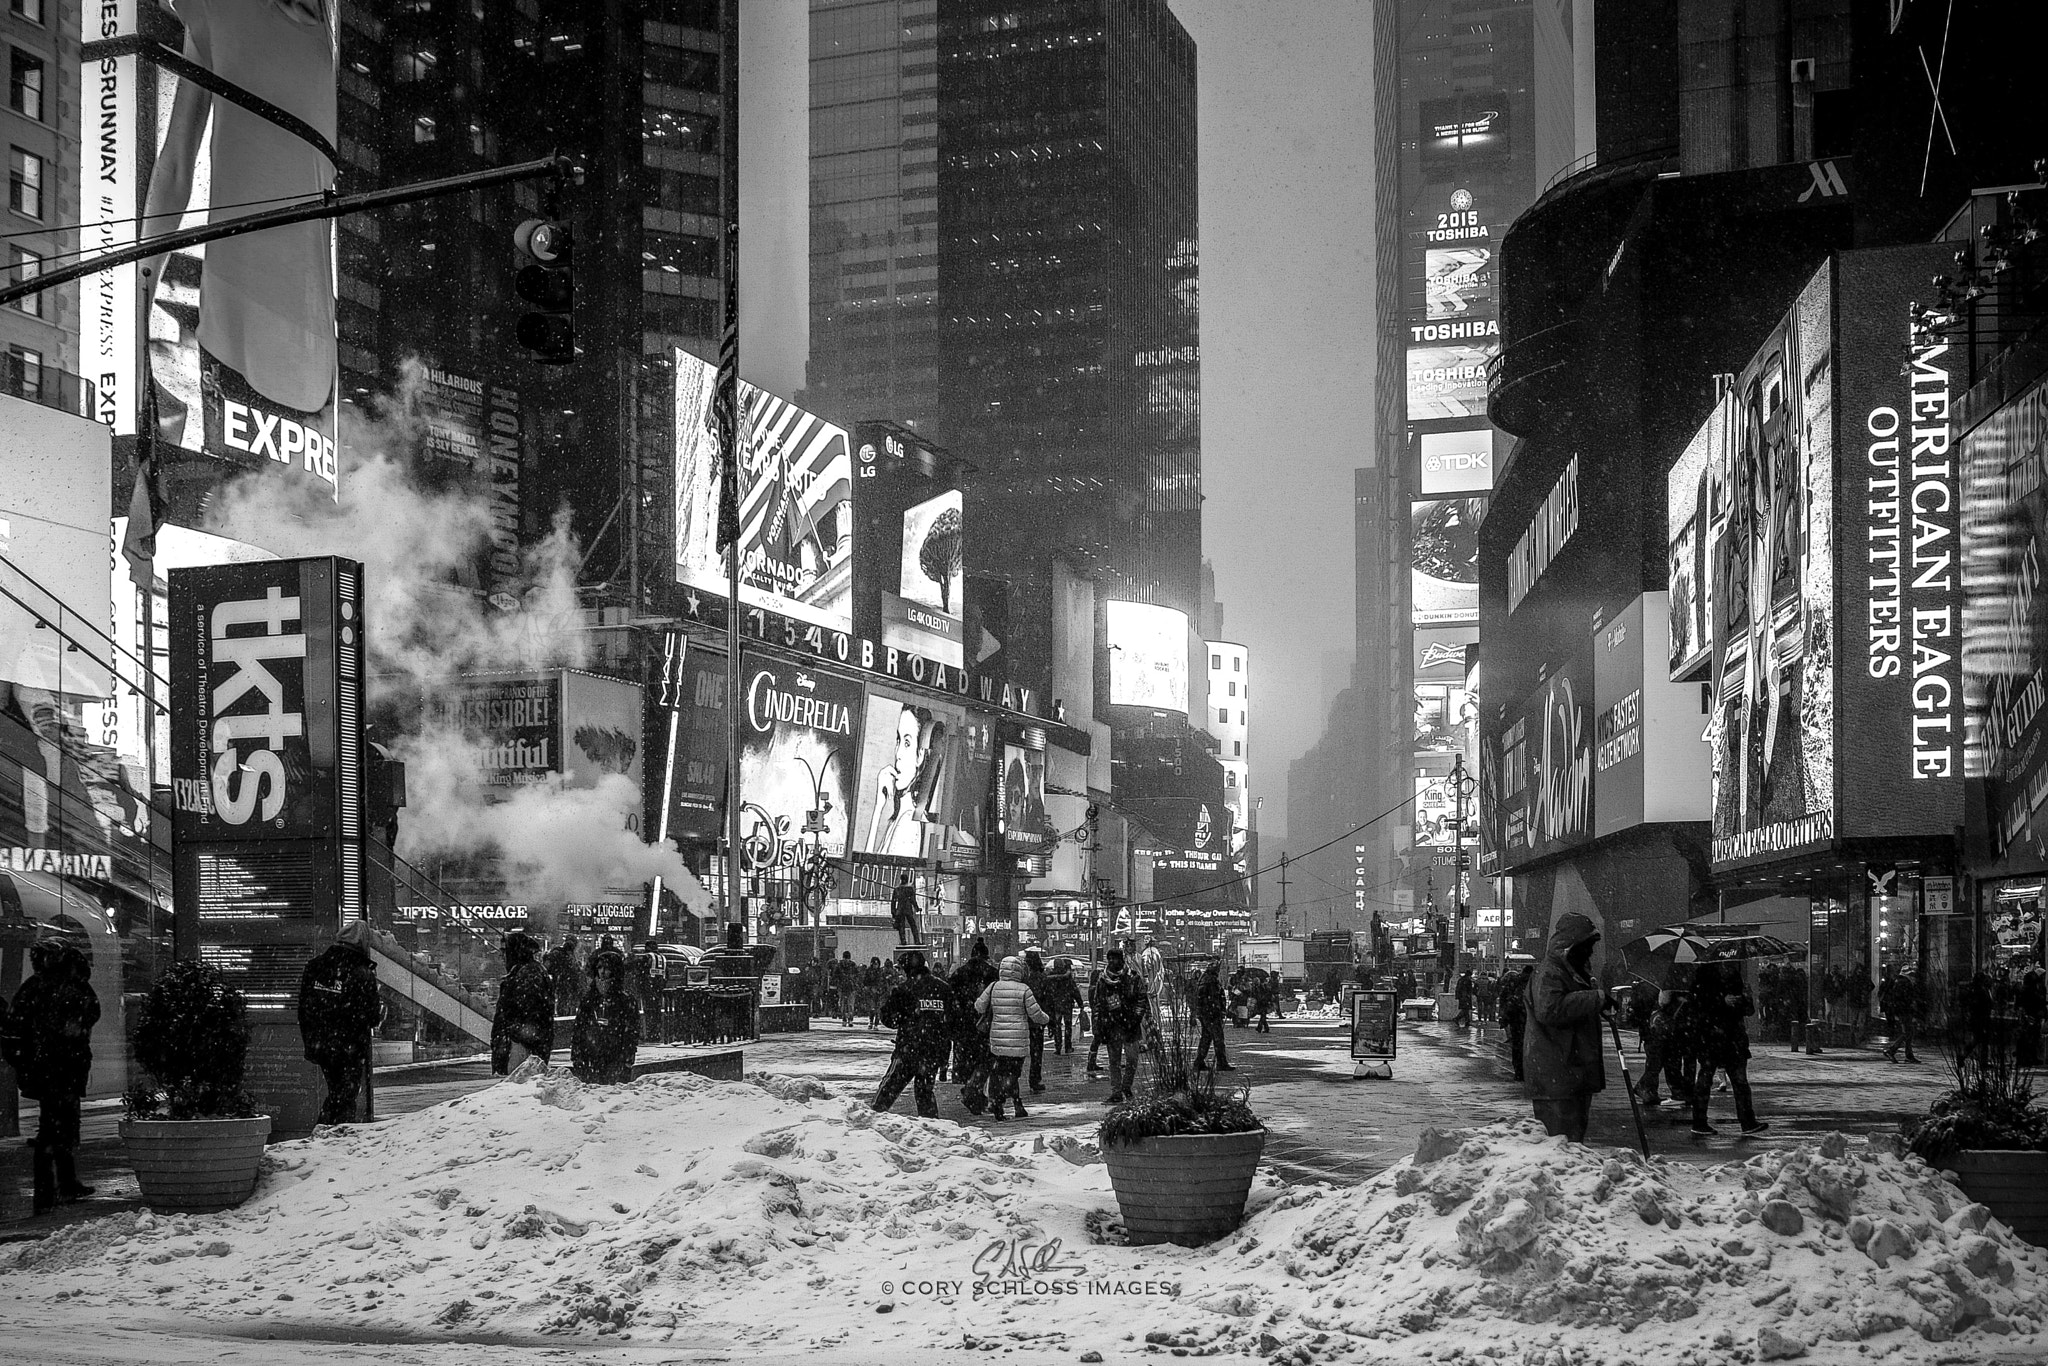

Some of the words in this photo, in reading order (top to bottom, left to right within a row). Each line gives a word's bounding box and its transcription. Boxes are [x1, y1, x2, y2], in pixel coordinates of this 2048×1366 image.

[1438, 211, 1478, 228] 2015
[1427, 226, 1489, 242] TOSHIBA
[1411, 320, 1499, 341] TOSHIBA
[430, 369, 482, 394] HILARIOUS
[1412, 366, 1486, 382] TOSHIBA
[861, 466, 876, 477] LG
[1440, 452, 1488, 470] TDK
[1867, 406, 1900, 679] OUTFITTERS
[197, 615, 206, 655] service
[941, 617, 950, 633] TV
[197, 658, 207, 670] of
[752, 609, 848, 661] 1540
[862, 639, 1030, 712] BROADWAY
[197, 673, 207, 716] Theatre
[536, 686, 549, 699] THE
[1911, 604, 1951, 779] EAGLE
[210, 586, 307, 825] tkts
[748, 671, 850, 735] CINDERELLA
[1614, 689, 1640, 734] FASTEST
[2007, 666, 2046, 748] GUIDE
[1613, 725, 1640, 766] NETWORK
[197, 719, 208, 794] Development
[490, 772, 512, 787] King
[1424, 790, 1442, 802] King
[199, 796, 209, 824] Fund
[451, 905, 528, 919] LUGGAGE
[567, 904, 592, 917] GIFTS
[597, 905, 635, 918] LUGGAGE
[919, 999, 944, 1009] TICKETS
